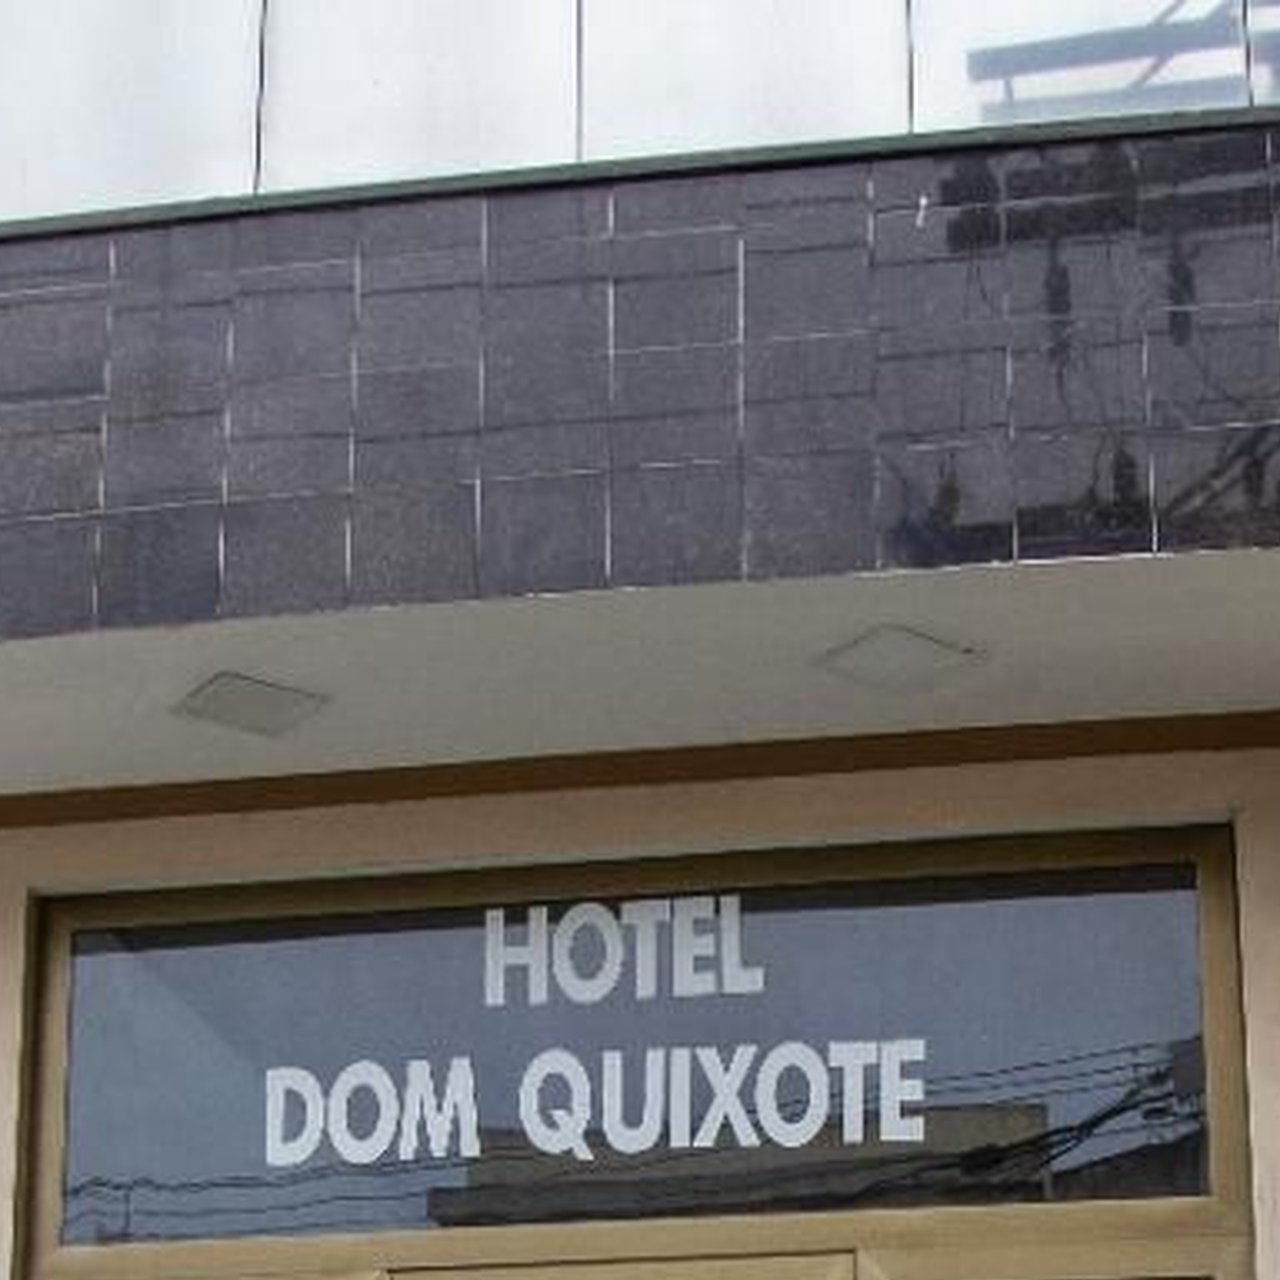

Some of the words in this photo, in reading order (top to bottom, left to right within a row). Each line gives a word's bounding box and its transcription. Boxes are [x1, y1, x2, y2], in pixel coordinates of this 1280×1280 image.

[483, 895, 765, 1006] HOTEL
[265, 1056, 481, 1168] DOM
[518, 1038, 926, 1162] QUIXOTE
